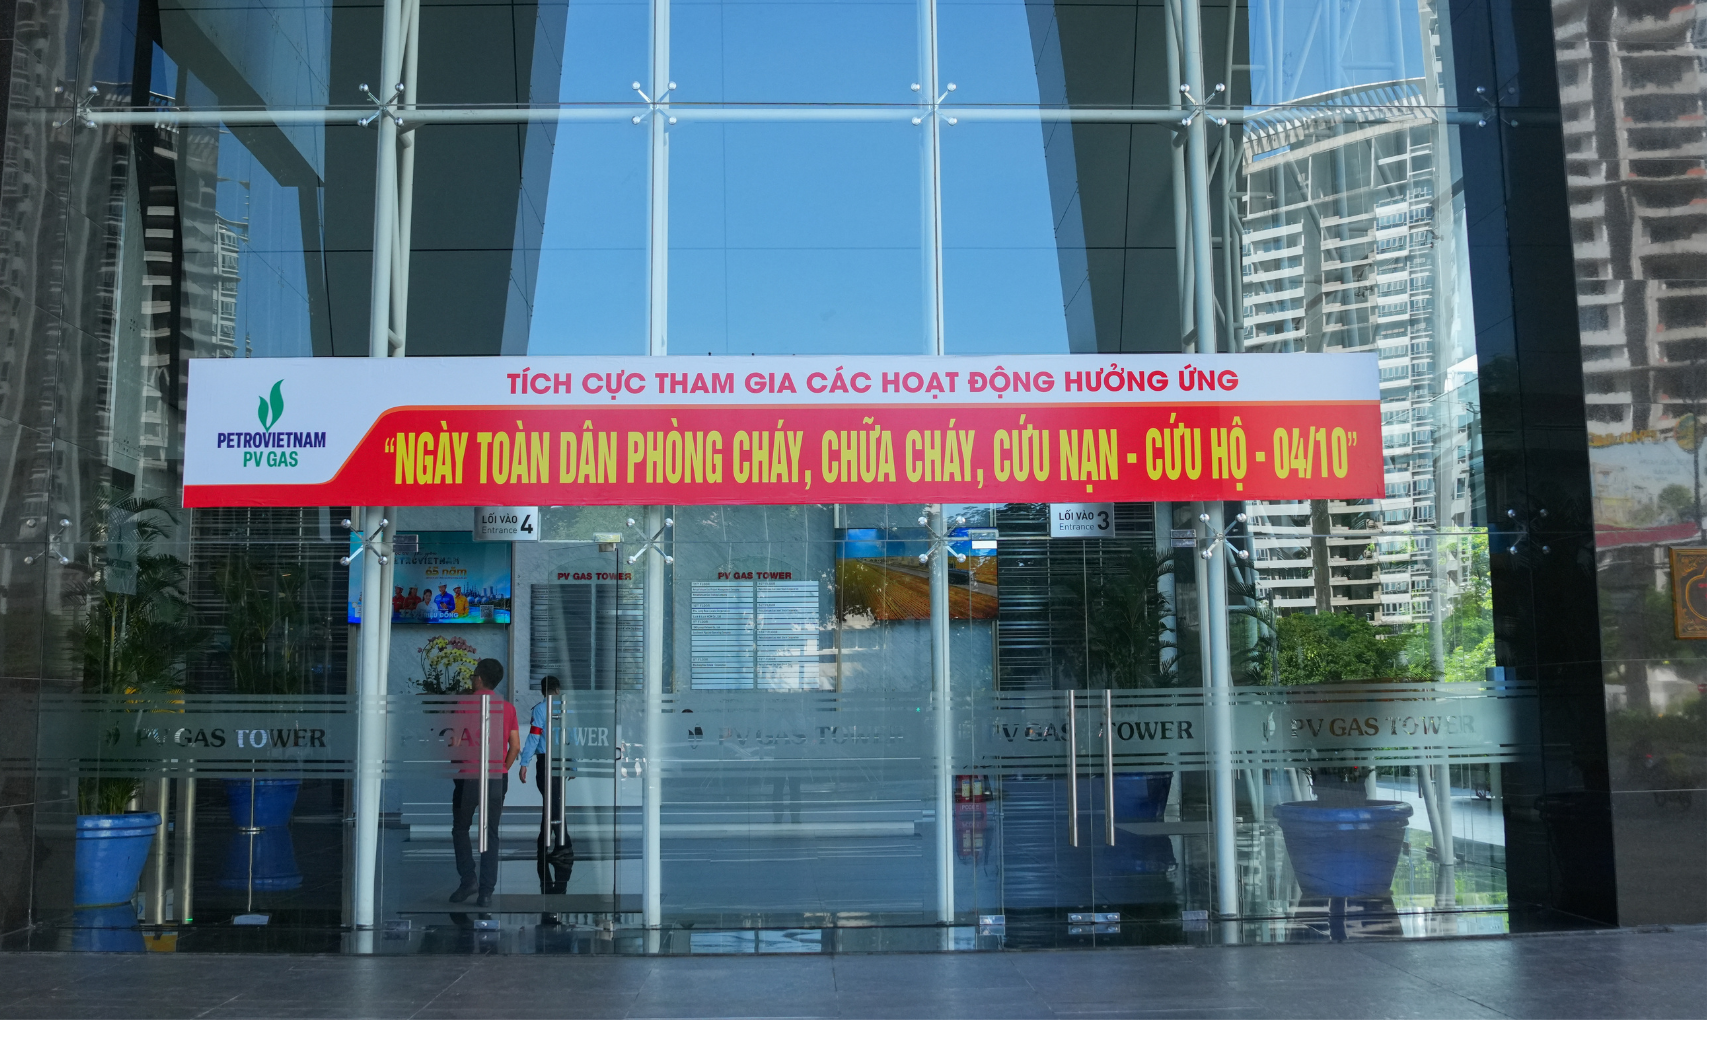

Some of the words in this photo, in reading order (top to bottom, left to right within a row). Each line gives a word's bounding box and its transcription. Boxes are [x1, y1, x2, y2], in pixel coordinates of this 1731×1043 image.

[507, 366, 571, 395] TÍCH
[582, 370, 646, 401] CỰC
[655, 372, 734, 394] THAM
[744, 372, 797, 394] GIA
[806, 365, 872, 394] CÁC
[882, 371, 959, 400] HOẠT
[968, 365, 1055, 399] ĐỘNG
[1065, 363, 1169, 393] HƯỞNG
[1179, 363, 1239, 392] ỨNG
[217, 431, 326, 449] PETROVIETNAM
[243, 450, 264, 468] PV
[266, 450, 298, 468] GAS
[477, 419, 550, 485] TOÀN
[560, 422, 618, 484] DÂN
[628, 418, 723, 484] PHÒNG
[733, 420, 812, 489] CHÁY,
[822, 418, 897, 483] CHỮA
[905, 418, 984, 488] CHÁY,
[994, 414, 1050, 481] CỨU
[1060, 428, 1119, 493] NẠN
[1145, 412, 1202, 481] CỨU
[1210, 416, 1248, 491] HỘ
[482, 512, 497, 524] LỐI
[500, 513, 518, 524] VÀO
[520, 514, 534, 534] 4
[1059, 509, 1074, 521] LỐI
[1076, 510, 1094, 521] VÀO
[1097, 511, 1110, 531] 3
[482, 525, 518, 534] Entrance
[1059, 522, 1095, 531] Entrance
[393, 556, 460, 566] ETROVIETNAM
[557, 572, 571, 581] PV
[573, 572, 593, 581] GAS
[595, 572, 632, 581] TOWER
[717, 571, 732, 580] PV
[733, 571, 754, 580] GAS
[756, 571, 792, 580] TOWER
[1290, 718, 1324, 739] PV
[1328, 717, 1379, 738] GAS
[1385, 714, 1476, 737] TOWER
[135, 727, 169, 748] PV
[174, 727, 226, 748] GAS
[235, 728, 327, 748] TOWER
